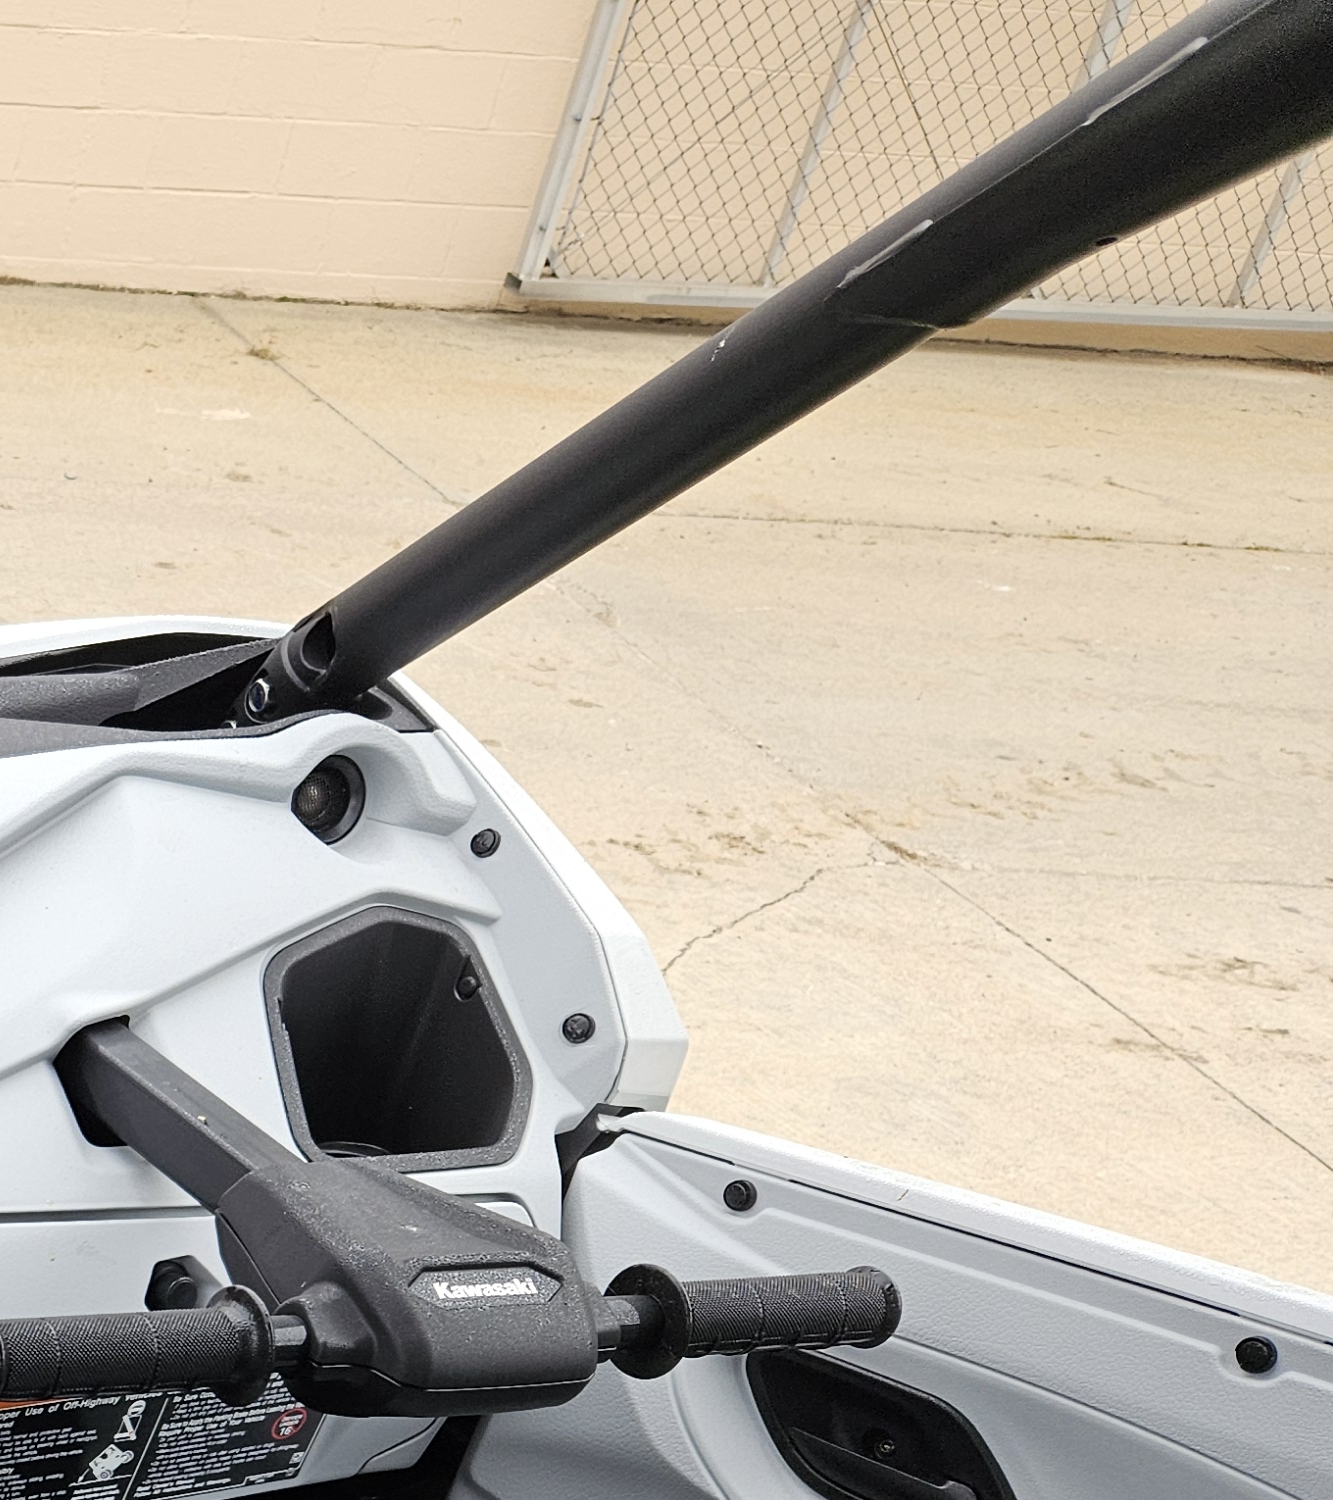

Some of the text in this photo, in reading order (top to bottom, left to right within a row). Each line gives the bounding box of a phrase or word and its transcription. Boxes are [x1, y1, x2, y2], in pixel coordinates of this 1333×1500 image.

[433, 1277, 539, 1300] Kawasaki
[25, 1407, 44, 1416] Use
[48, 1403, 58, 1413] of
[63, 1396, 121, 1410] Off-Highway
